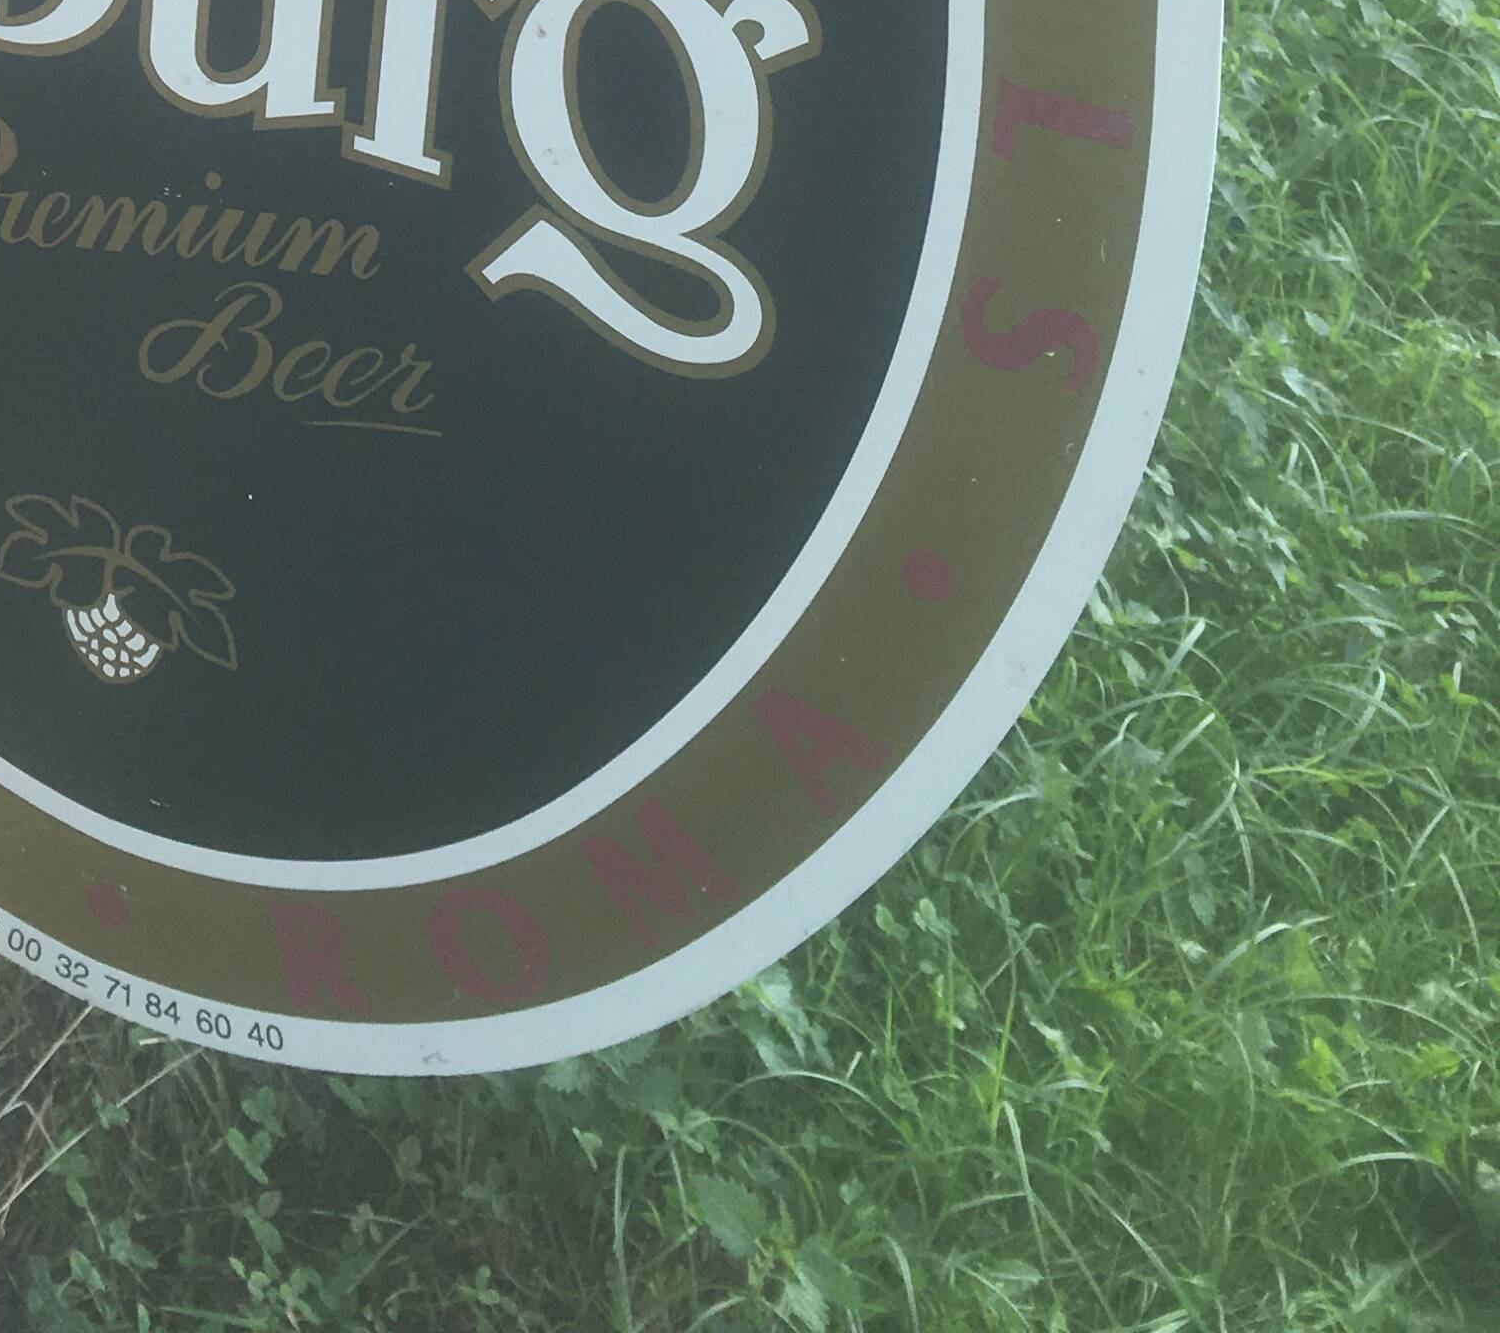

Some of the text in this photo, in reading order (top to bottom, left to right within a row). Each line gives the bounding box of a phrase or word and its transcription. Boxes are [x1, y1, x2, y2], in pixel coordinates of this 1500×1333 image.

[138, 281, 436, 413] Beer
[268, 687, 893, 1016] ROMA
[7, 928, 42, 962] 00
[55, 953, 90, 988] 32
[104, 974, 132, 1007] 71
[145, 992, 181, 1025] 84
[196, 1008, 231, 1040] 60
[247, 1022, 284, 1051] 40
